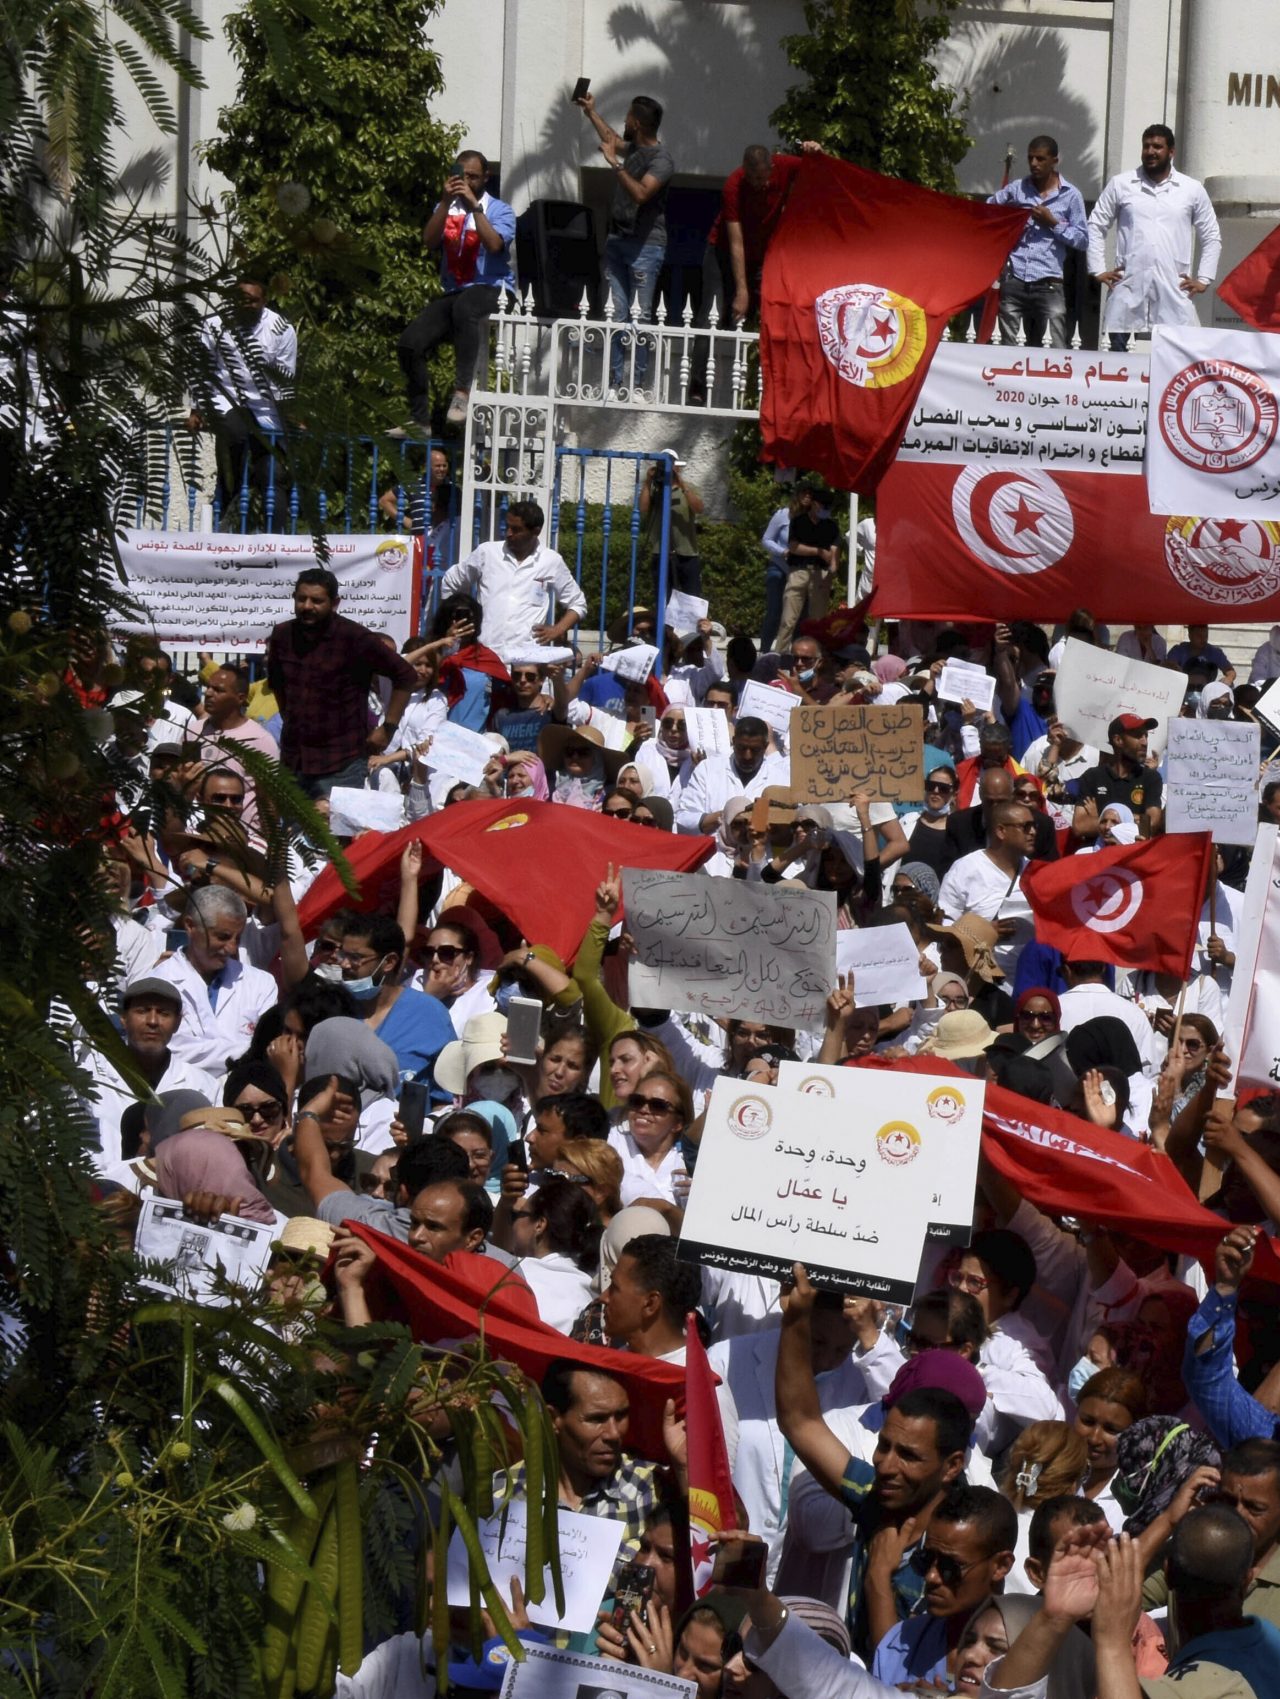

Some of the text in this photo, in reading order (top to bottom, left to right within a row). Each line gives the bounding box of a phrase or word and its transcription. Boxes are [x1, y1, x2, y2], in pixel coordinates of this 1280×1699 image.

[981, 356, 1129, 388] عام قطاعي
[995, 390, 1026, 403] 2020
[1028, 393, 1061, 406] جوان
[1065, 394, 1079, 406] 18
[1081, 396, 1138, 412] الخميس
[913, 407, 963, 428] الفصل
[967, 413, 1010, 431] سحب
[1014, 418, 1022, 431] و
[1038, 443, 1084, 463] احترام
[1088, 450, 1096, 462] و
[136, 542, 169, 552] بتونس
[831, 1187, 849, 1210] يا
[731, 1203, 848, 1239] سلطة رأس المال
[699, 1249, 729, 1264] بتونس
